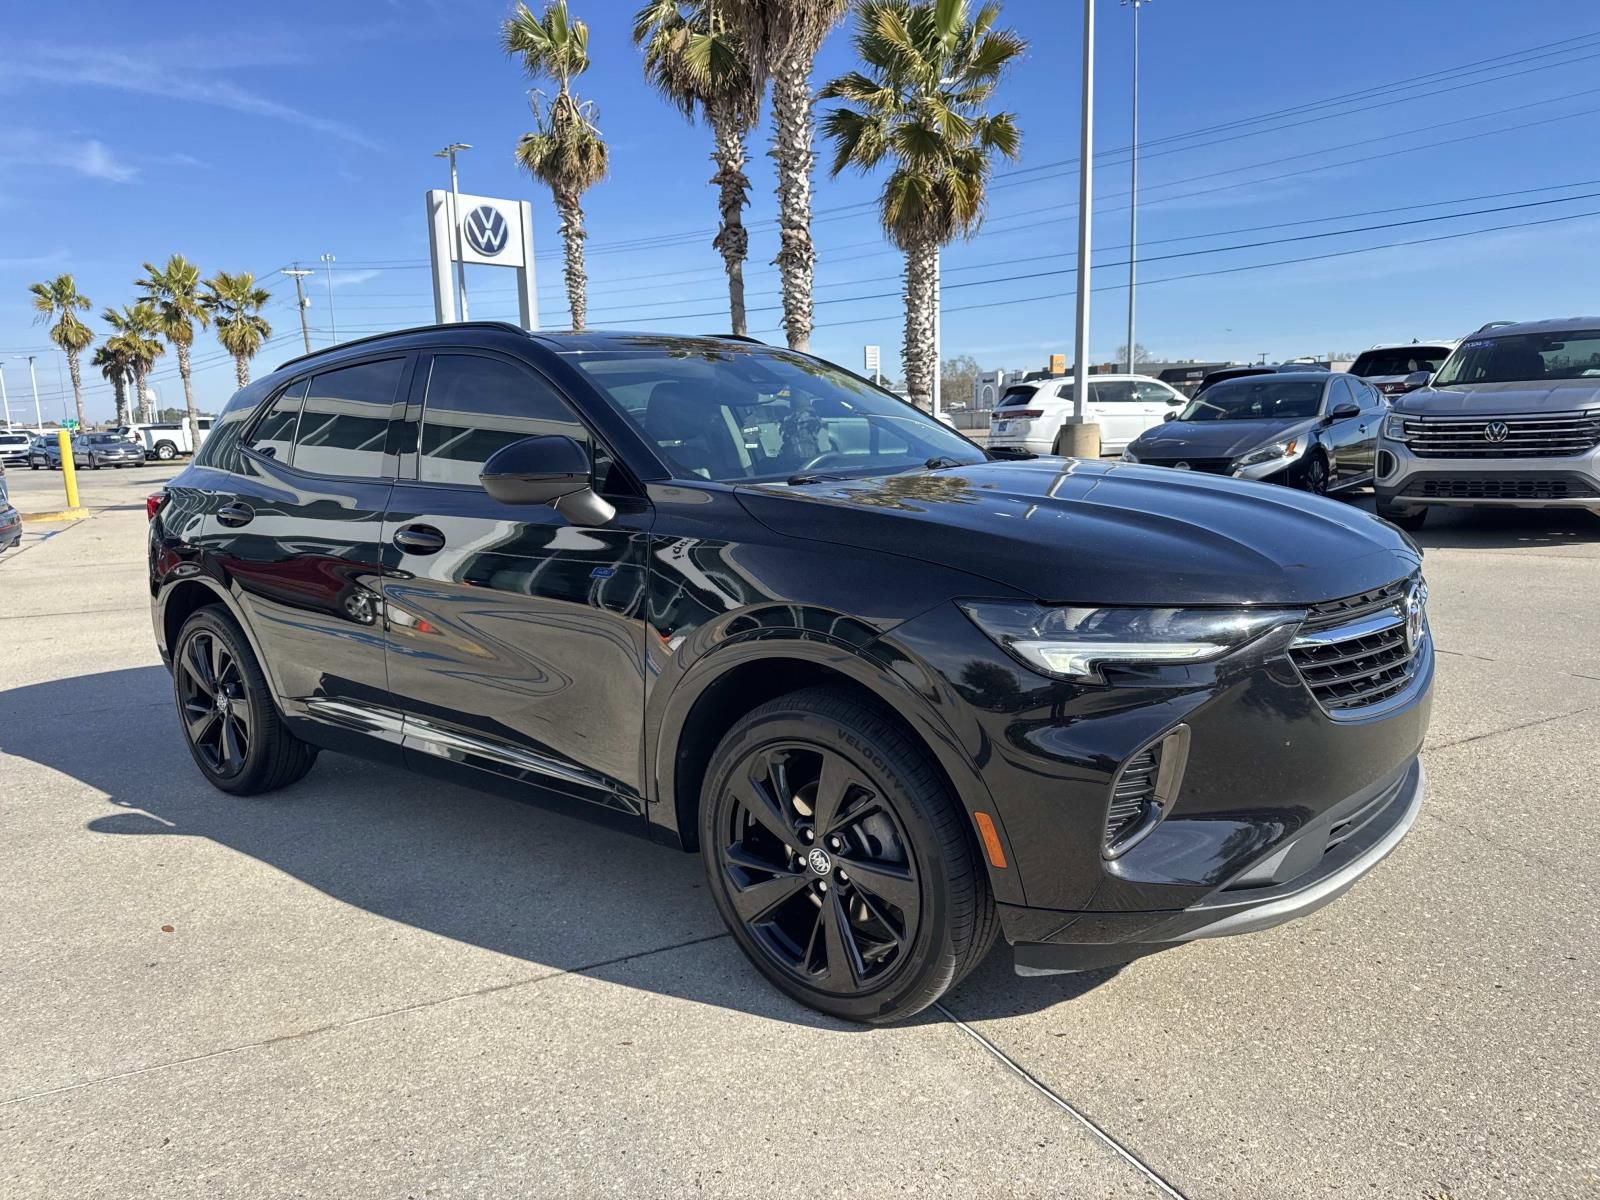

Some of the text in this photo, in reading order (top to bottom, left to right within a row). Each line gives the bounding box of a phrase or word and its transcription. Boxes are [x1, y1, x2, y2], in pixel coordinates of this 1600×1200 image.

[466, 206, 508, 254] VW
[1485, 421, 1508, 442] VW
[837, 728, 904, 789] VELOCITY
